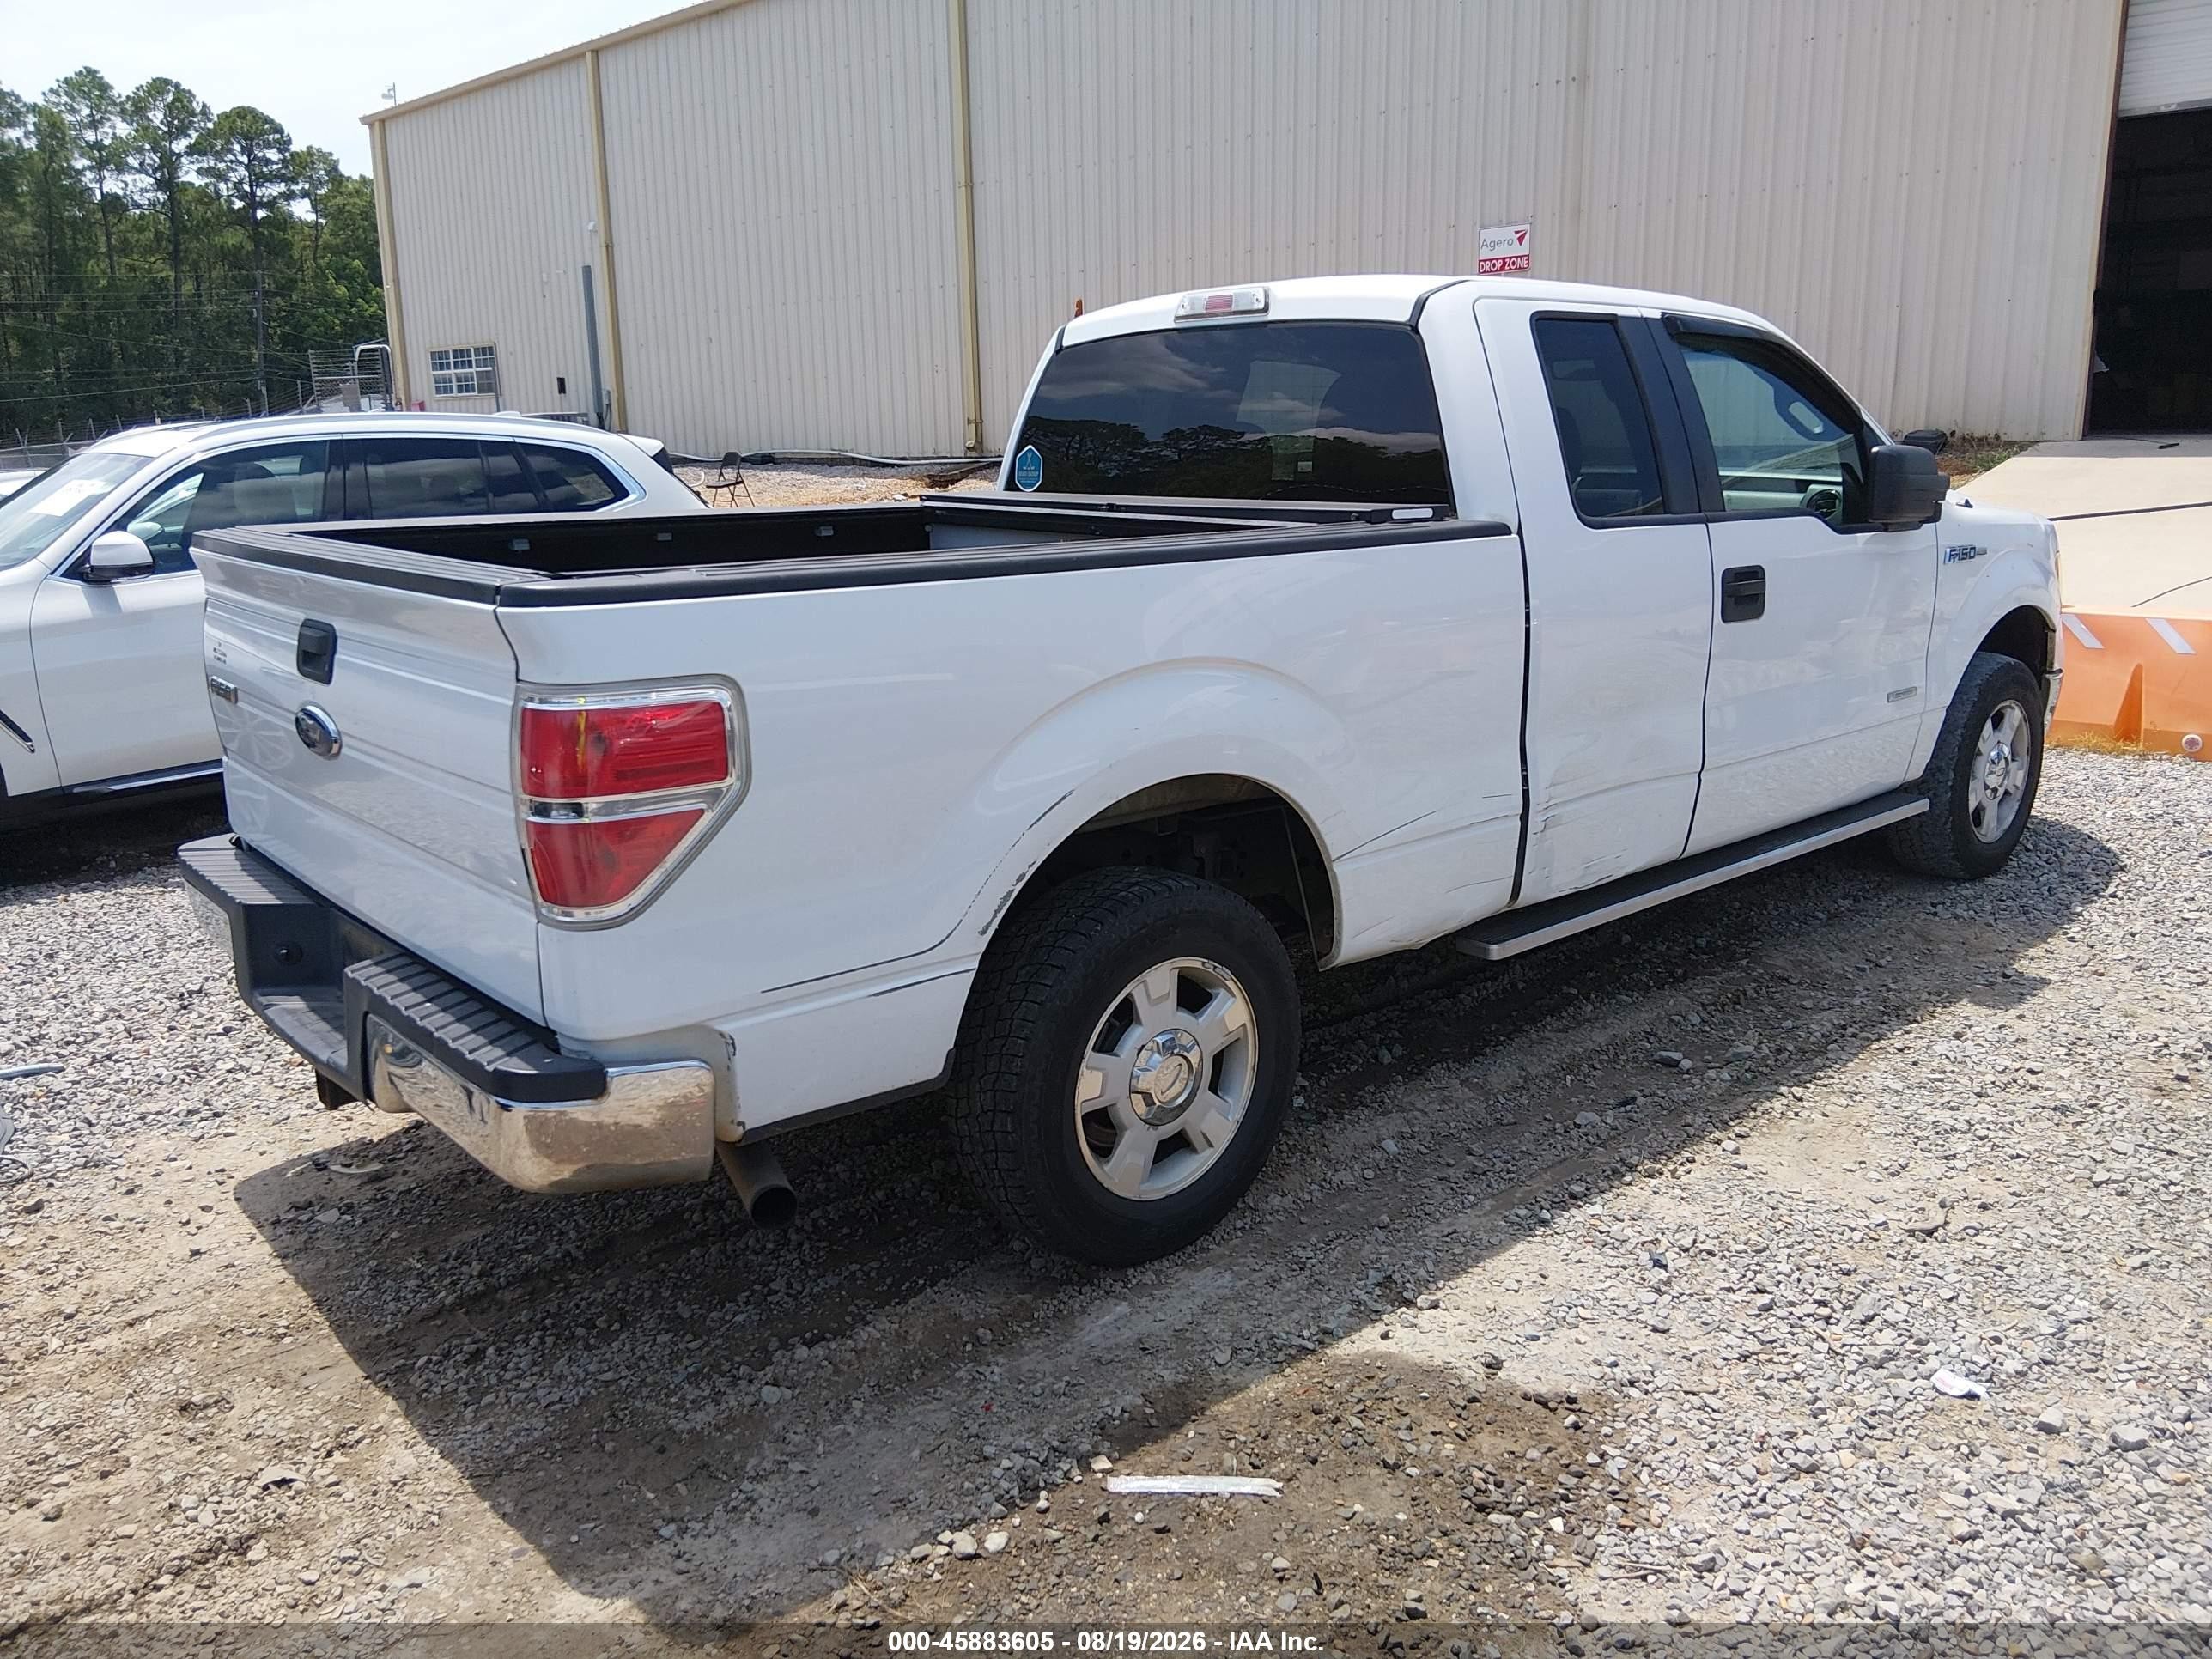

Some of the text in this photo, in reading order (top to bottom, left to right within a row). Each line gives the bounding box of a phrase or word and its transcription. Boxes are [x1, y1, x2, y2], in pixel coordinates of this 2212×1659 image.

[1480, 238, 1514, 252] Agero
[1480, 256, 1528, 273] DROP ZONE
